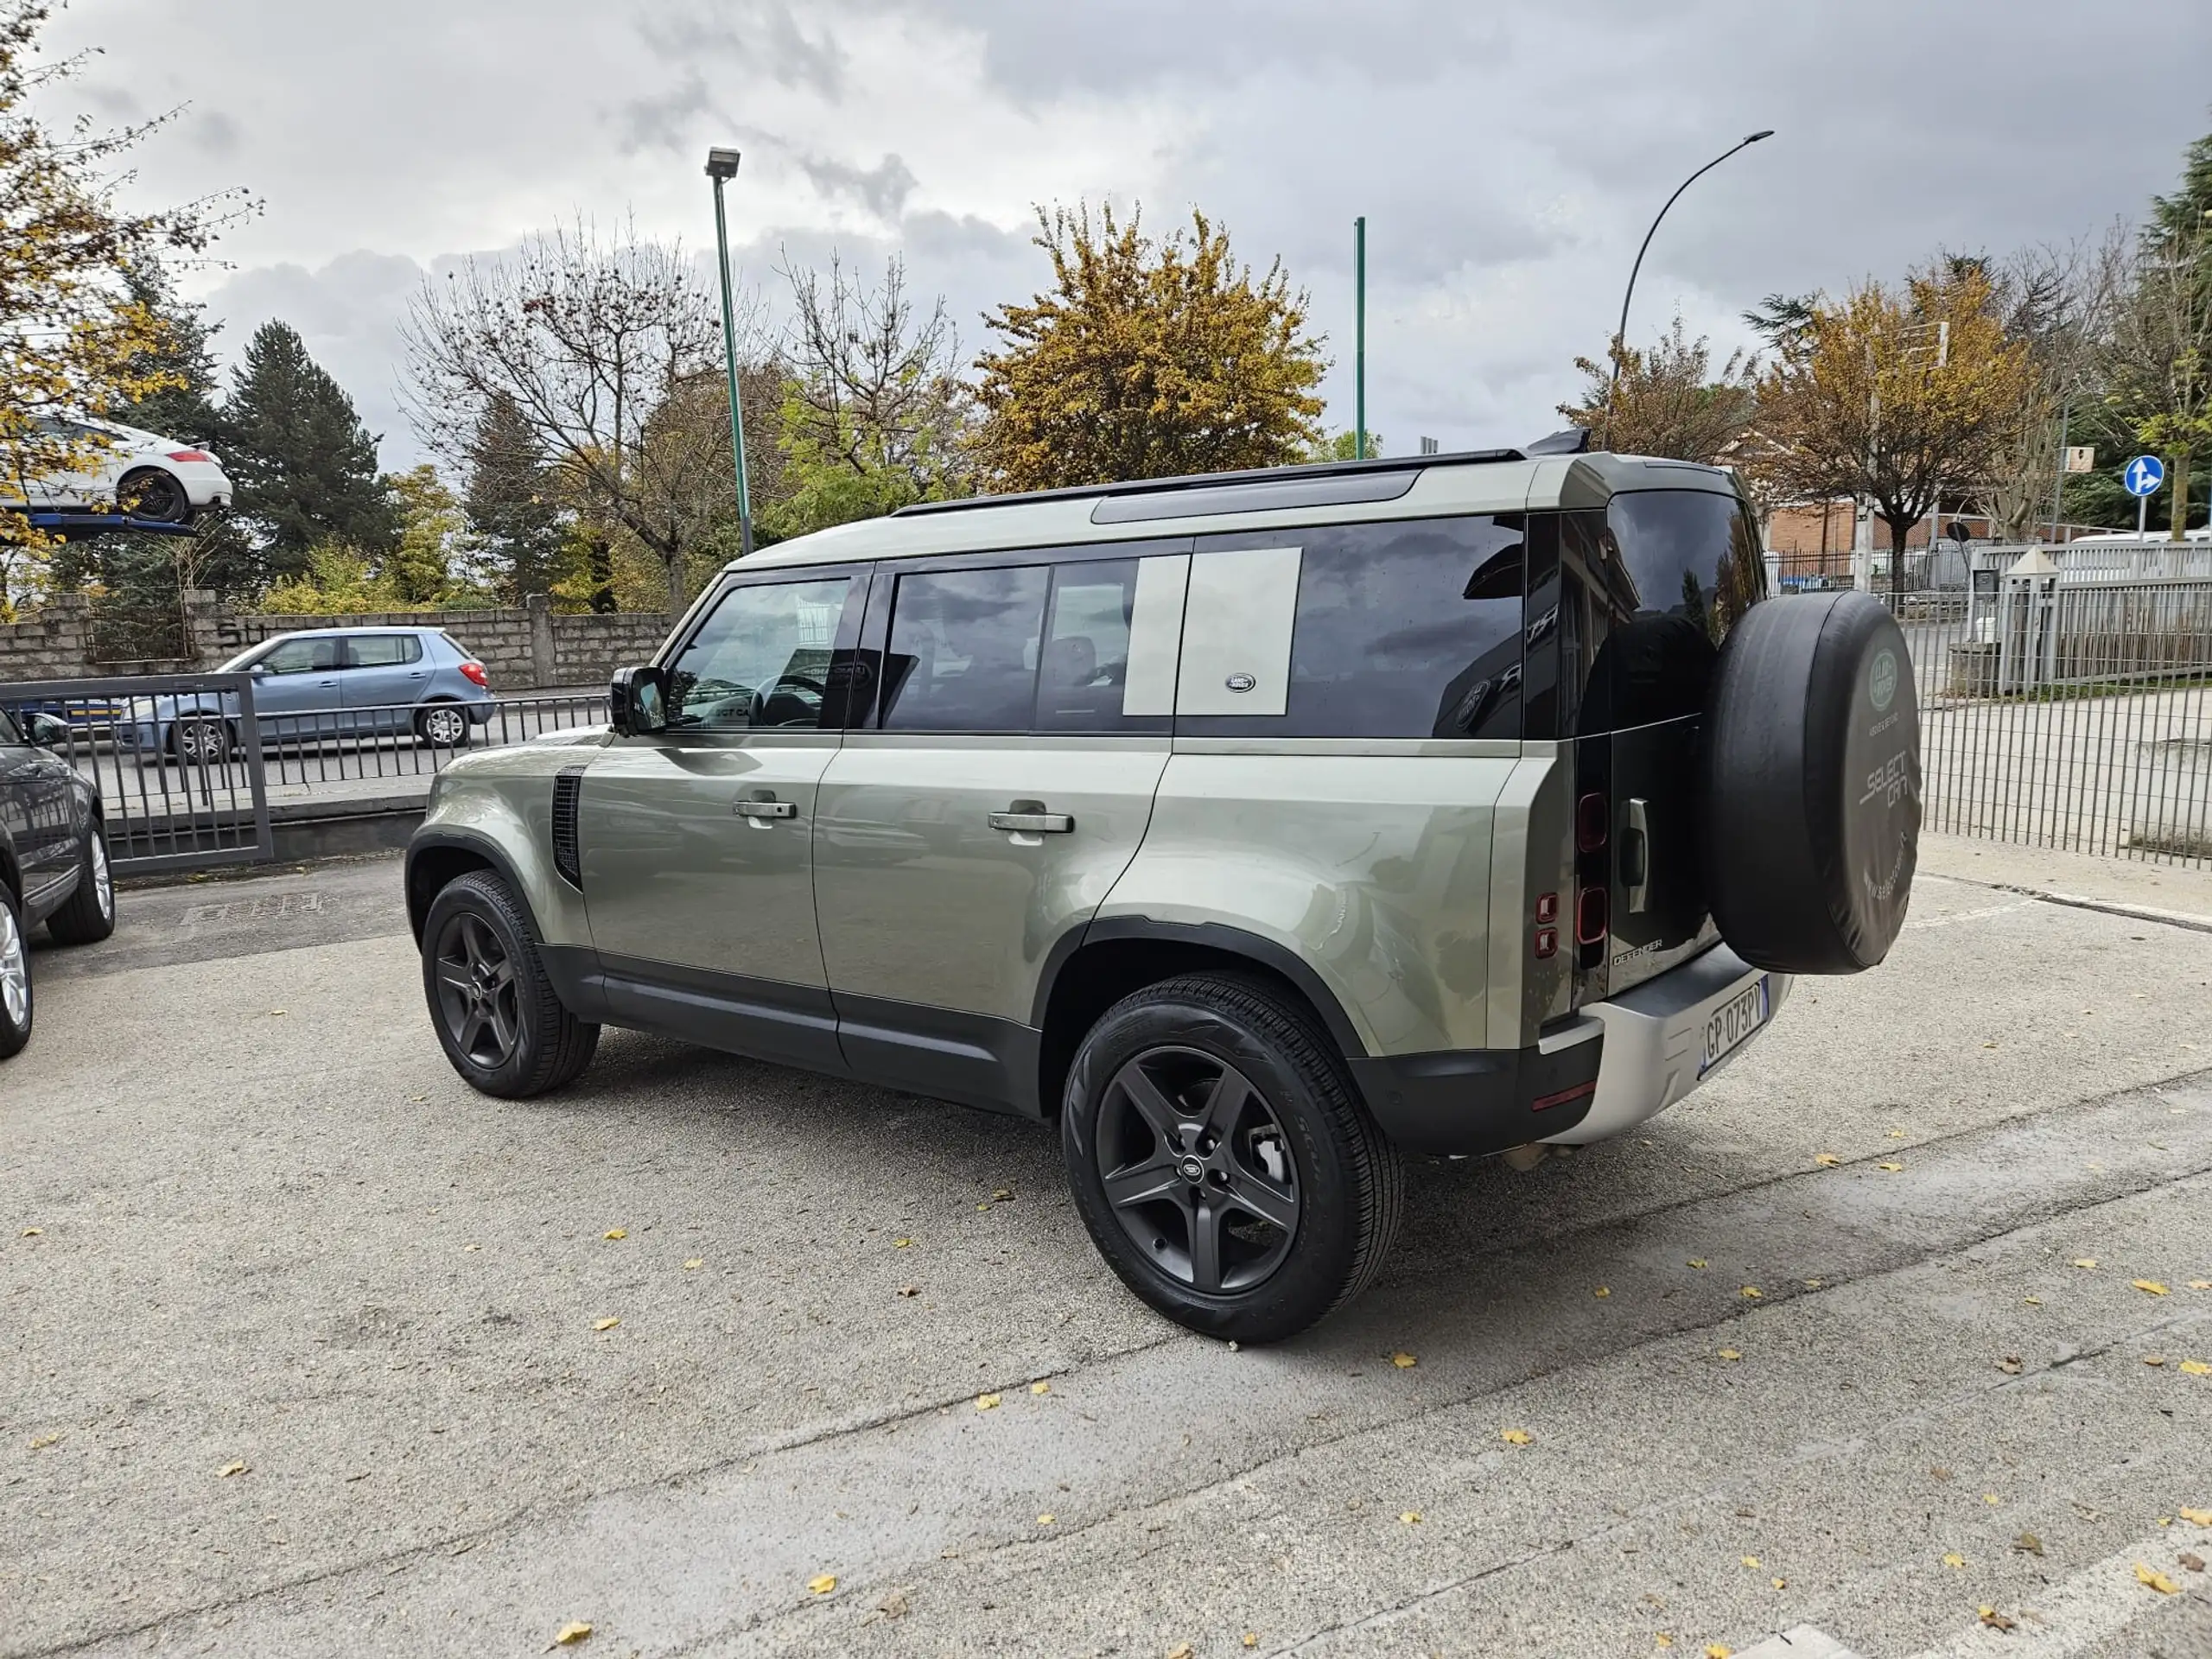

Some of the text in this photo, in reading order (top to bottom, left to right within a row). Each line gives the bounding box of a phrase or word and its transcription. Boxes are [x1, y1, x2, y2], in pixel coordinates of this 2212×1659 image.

[1613, 938, 1662, 966] DEFENDER
[1707, 982, 1760, 1058] GP 073PV
